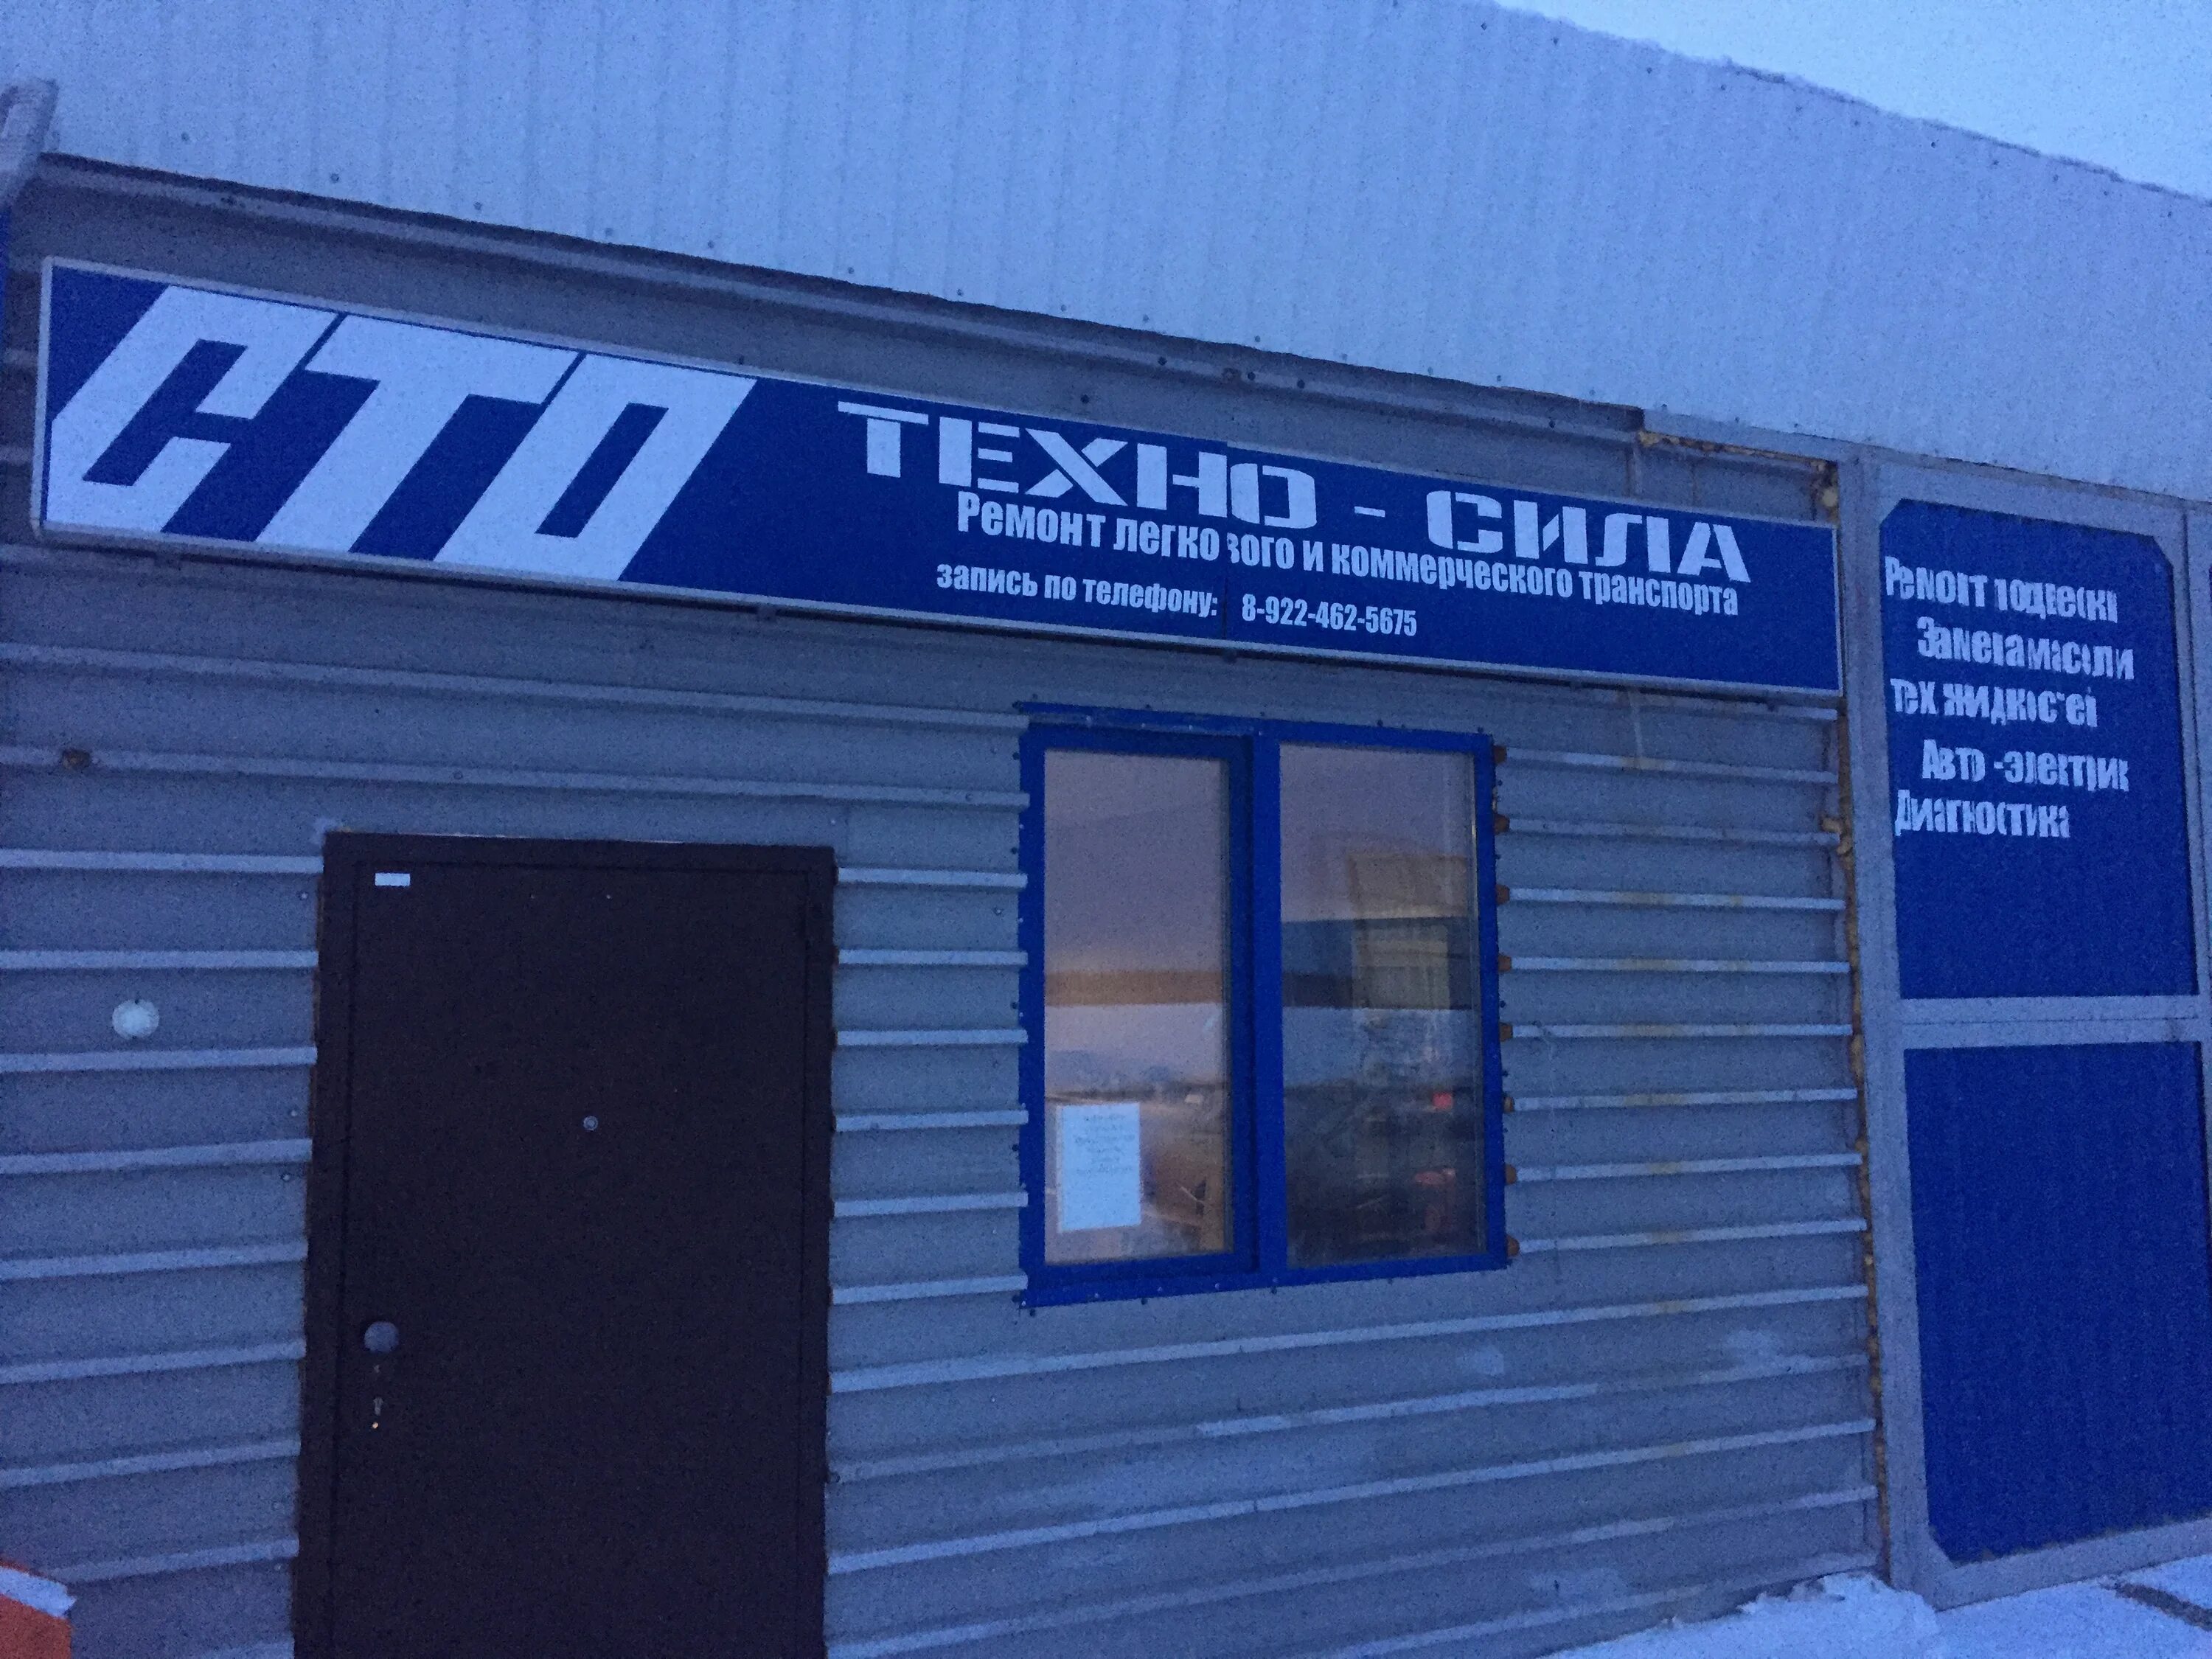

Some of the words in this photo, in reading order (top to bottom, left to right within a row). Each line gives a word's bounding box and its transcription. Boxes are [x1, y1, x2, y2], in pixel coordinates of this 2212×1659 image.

[47, 285, 758, 581] СТО
[838, 401, 1317, 529] ТЕХНО
[1426, 490, 1751, 582] СИЛА
[936, 563, 1037, 597] запись
[1044, 574, 1077, 601] по
[1082, 578, 1218, 618] телефону:
[1242, 593, 1417, 636] 8-922-462-5675
[958, 491, 1106, 547] Ремонт
[1302, 540, 1324, 572] и
[1332, 543, 1573, 598] коммерческого
[1578, 571, 1738, 616] транспорта
